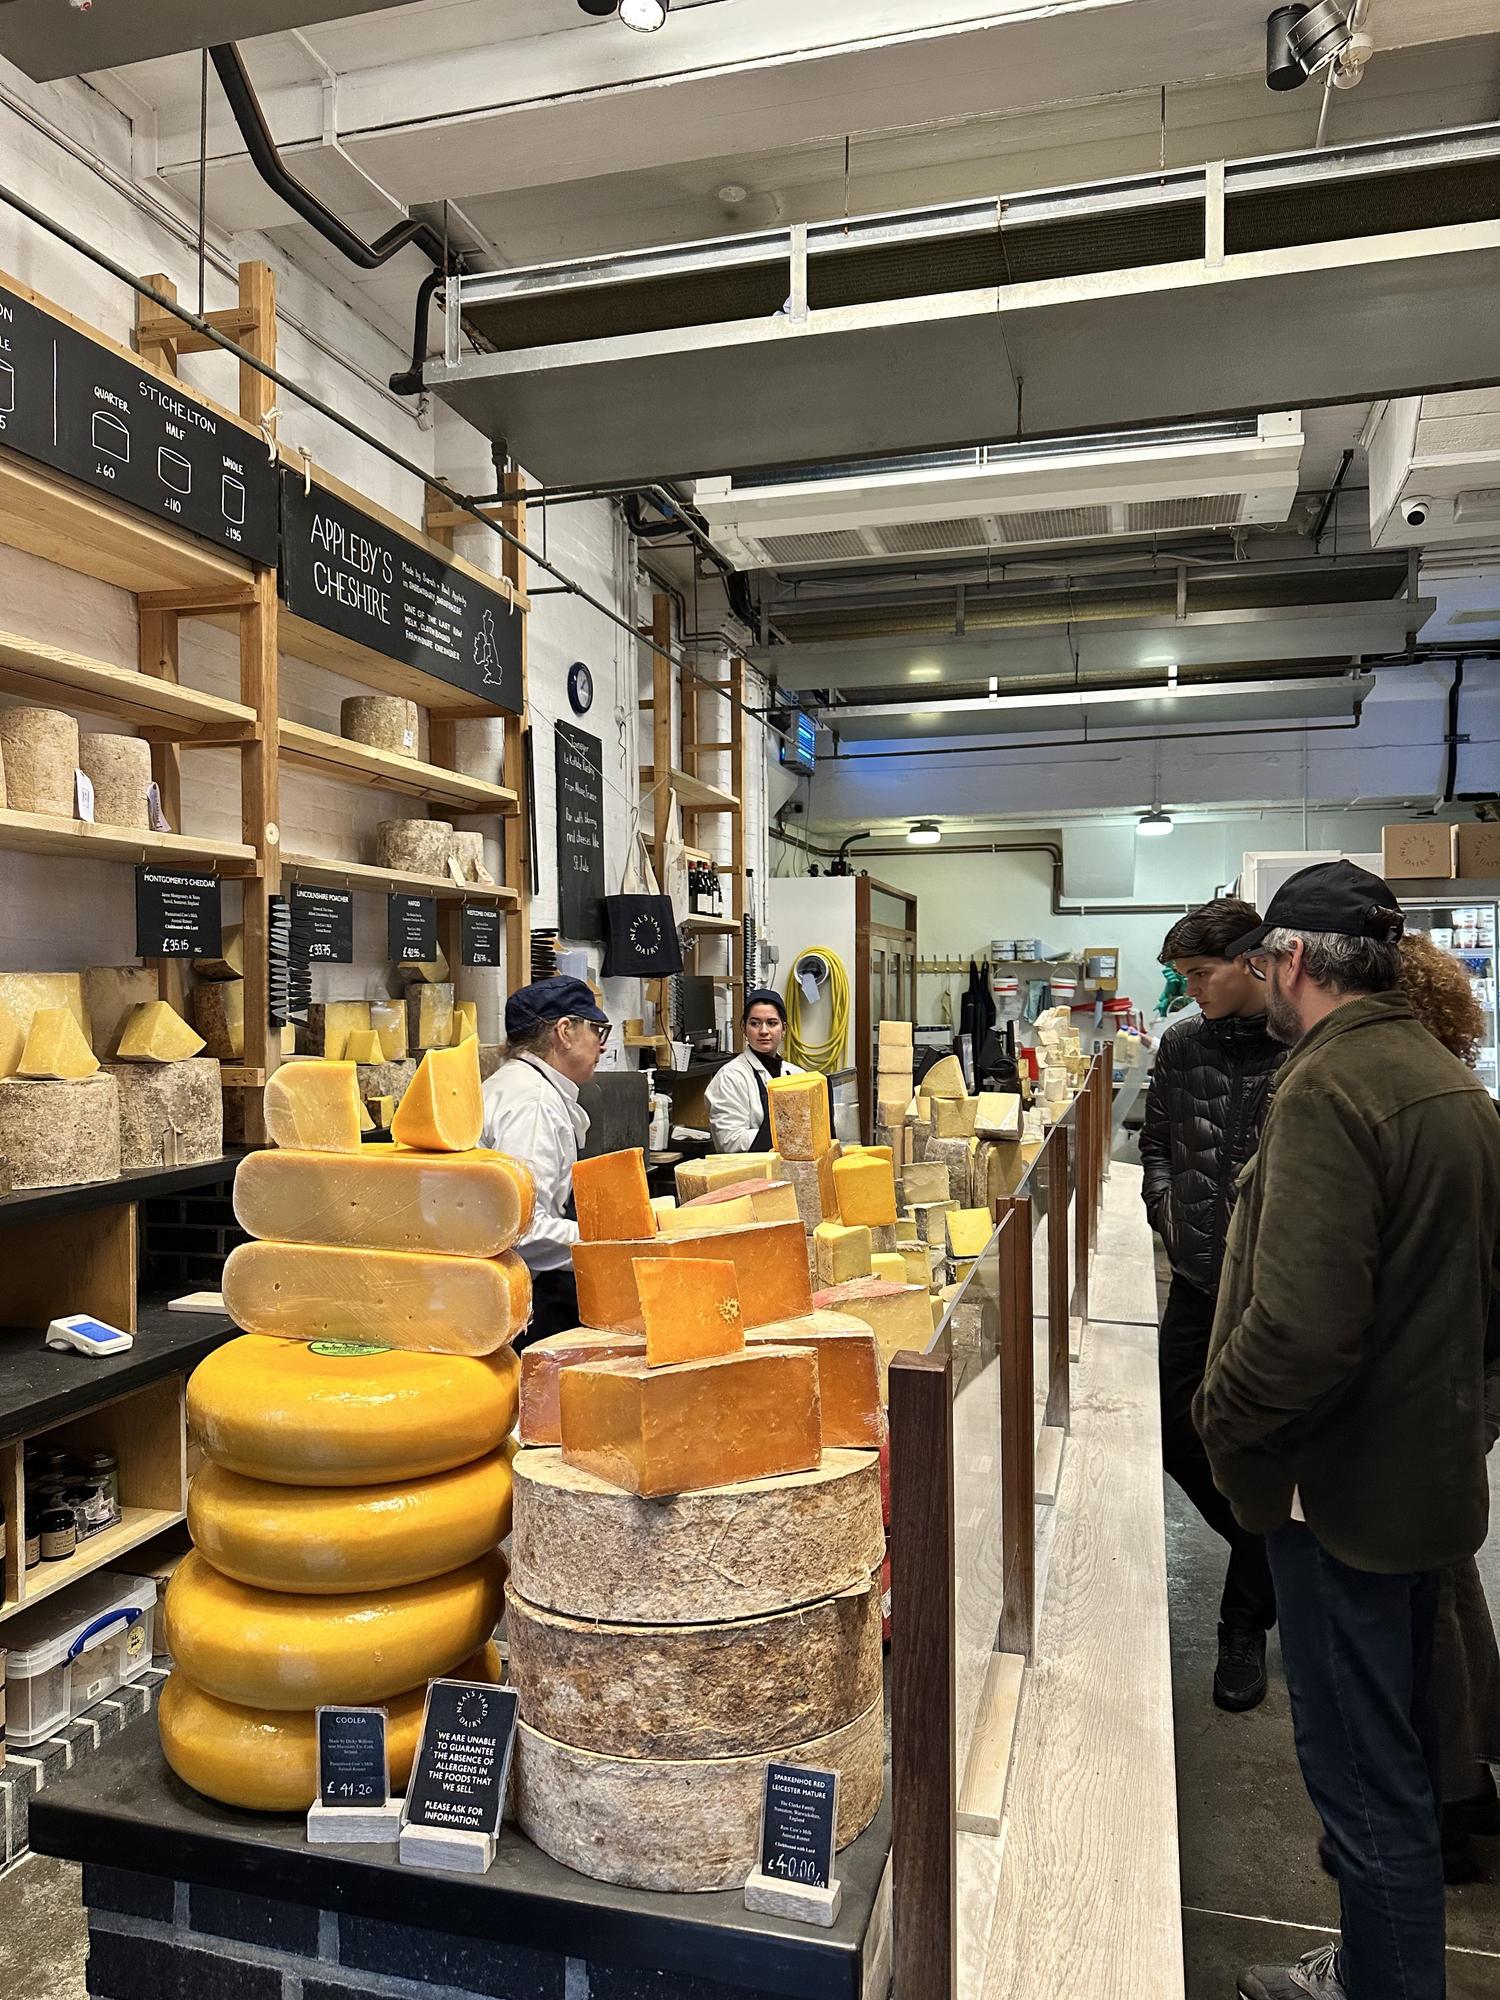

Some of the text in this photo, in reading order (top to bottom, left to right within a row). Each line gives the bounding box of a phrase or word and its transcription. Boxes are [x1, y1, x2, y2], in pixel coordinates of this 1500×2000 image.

[94, 386, 131, 414] QUARTER
[139, 382, 216, 435] STICHELTON
[166, 422, 186, 441] HALF
[96, 463, 115, 479] £60
[222, 456, 244, 476] WHOLE
[164, 498, 182, 513] £110
[225, 527, 242, 542] £195
[310, 514, 393, 584] APPLEBY'S
[314, 562, 391, 625] CHESHIRE
[404, 603, 417, 616] ONE
[417, 610, 425, 619] OF
[427, 614, 437, 625] THE
[438, 620, 451, 631] LAST
[144, 874, 216, 888] MONTGOMERY'S CHEDDAR
[296, 890, 349, 903] LINCOLNSHIRE POACHER
[630, 914, 662, 956] NEAL'S YARD DAIRY
[456, 1690, 489, 1728] NEAL'S YARD DAIRY
[336, 1716, 367, 1724] COOLEA
[438, 1732, 497, 1746] WE ARE UNABLE
[437, 1741, 494, 1756] TO GUARANTEE
[433, 1751, 495, 1766] THE ABSENCE OF
[436, 1762, 488, 1776] ALLERGENS IN
[429, 1771, 492, 1786] THE FOODS THAT
[774, 1774, 826, 1789] SPARKENHOE RED
[327, 1781, 336, 1794] £
[442, 1783, 474, 1794] WE SELL.
[772, 1784, 826, 1800] LEICESTER MATURE
[425, 1800, 483, 1816] PLEASE ASK FOR
[425, 1811, 480, 1826] INFORMATION.
